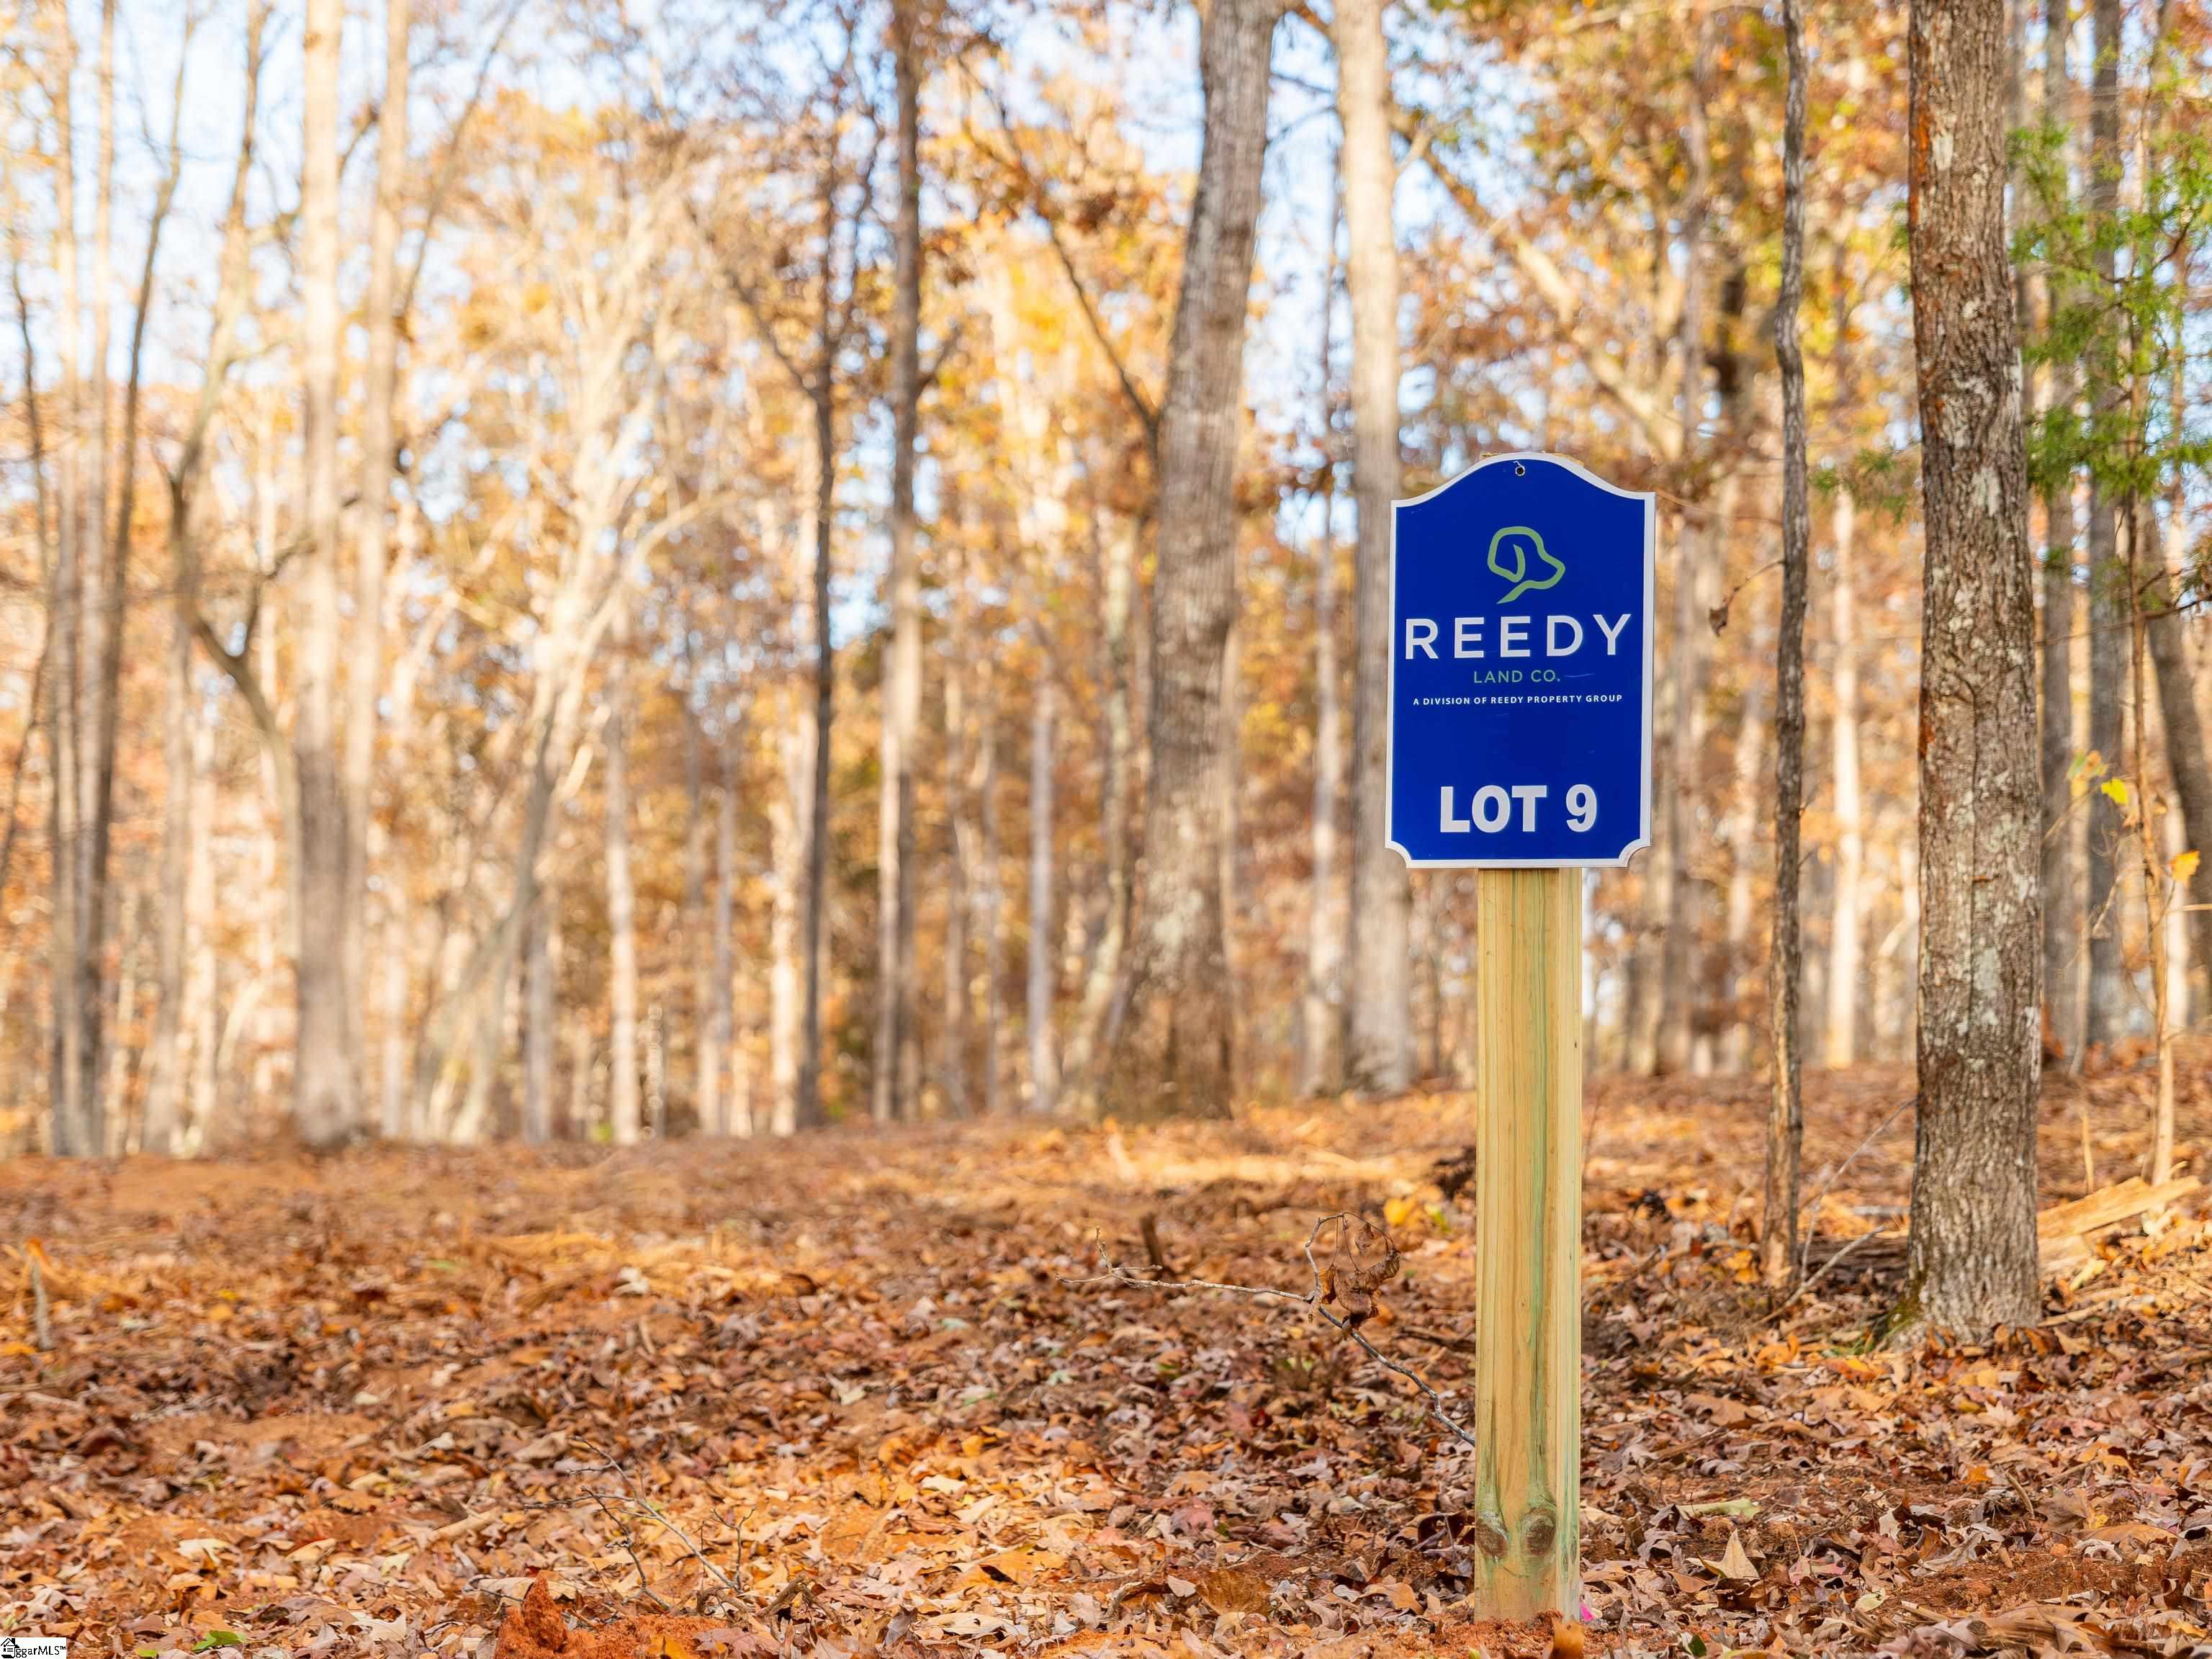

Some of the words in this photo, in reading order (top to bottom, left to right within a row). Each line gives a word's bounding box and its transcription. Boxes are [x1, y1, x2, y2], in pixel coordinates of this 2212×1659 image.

[1405, 613, 1632, 660] REEDY
[1473, 670, 1523, 684] LAND
[1530, 669, 1562, 683] CO.
[1423, 697, 1470, 706] DIVISION
[1473, 696, 1488, 705] OF
[1527, 695, 1582, 703] PROPERTY
[1585, 694, 1623, 703] GROUP
[1439, 784, 1547, 834] LOT
[1565, 783, 1597, 833] 9
